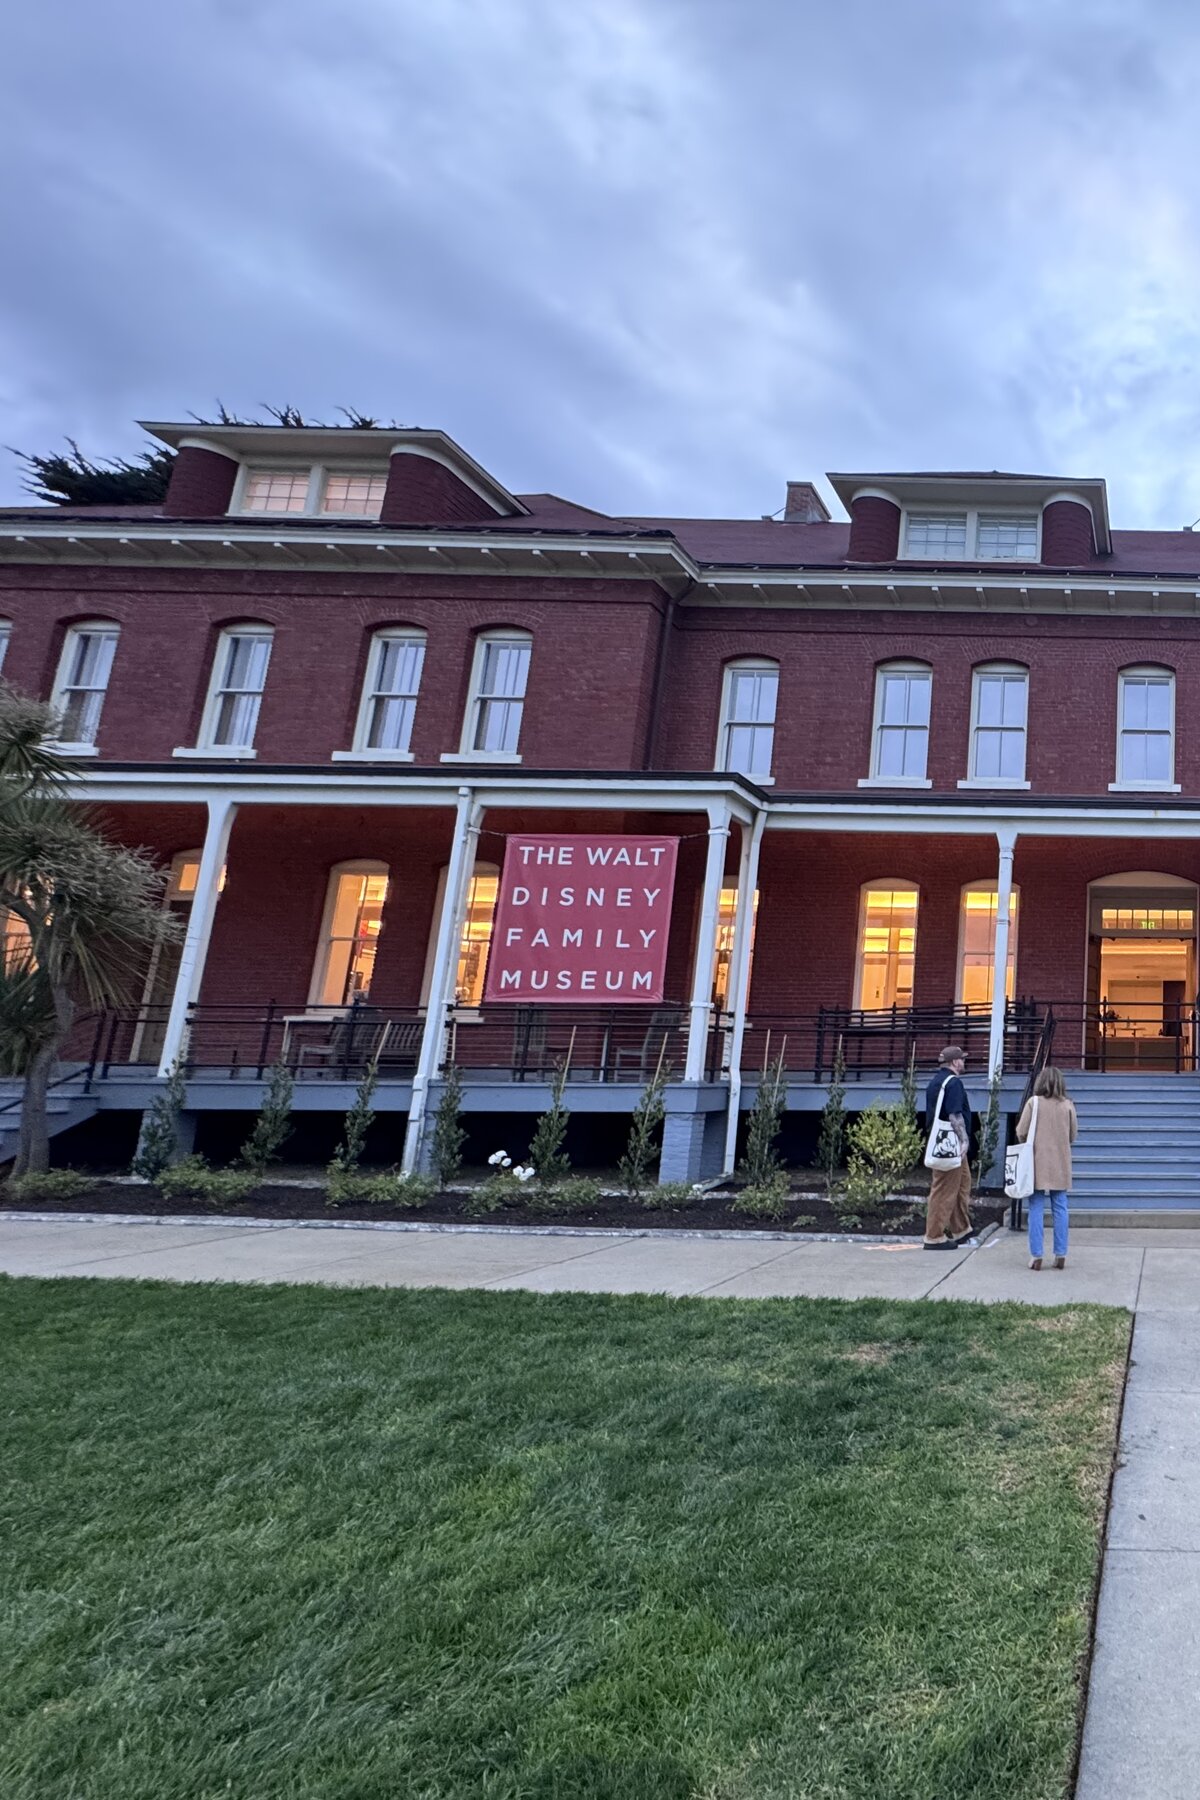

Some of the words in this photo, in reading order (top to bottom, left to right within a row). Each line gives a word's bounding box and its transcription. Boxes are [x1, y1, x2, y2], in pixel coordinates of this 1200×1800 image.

[520, 847, 573, 865] THE
[587, 848, 665, 865] WALT
[512, 887, 660, 906] DISNEY
[507, 928, 656, 948] FAMILY
[501, 970, 652, 990] MUSEUM
